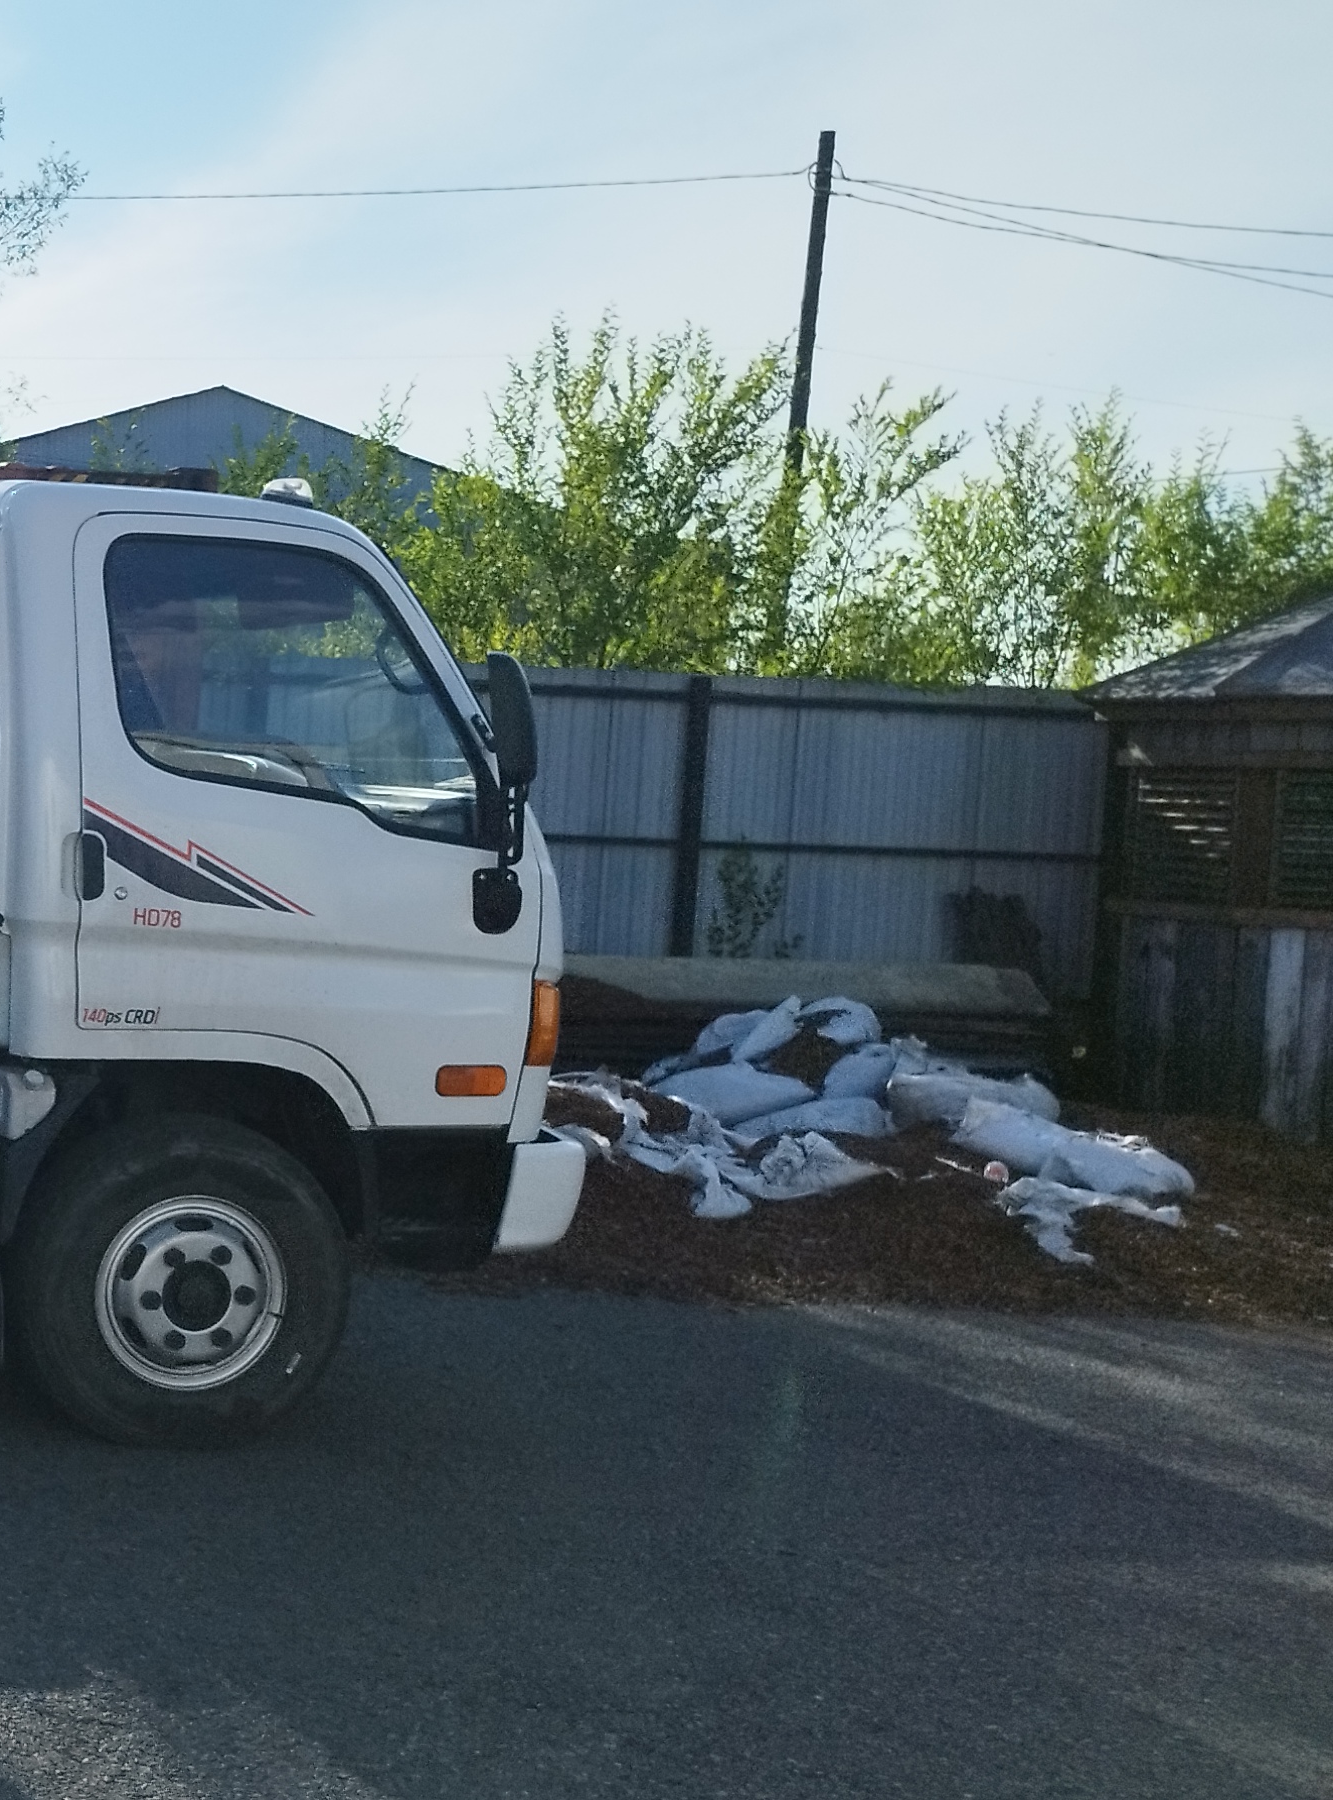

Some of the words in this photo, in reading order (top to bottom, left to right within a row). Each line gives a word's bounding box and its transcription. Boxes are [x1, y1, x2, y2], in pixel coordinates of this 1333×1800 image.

[133, 907, 182, 928] HD78
[82, 1007, 123, 1026] 140ps
[124, 1006, 161, 1025] CRDi
